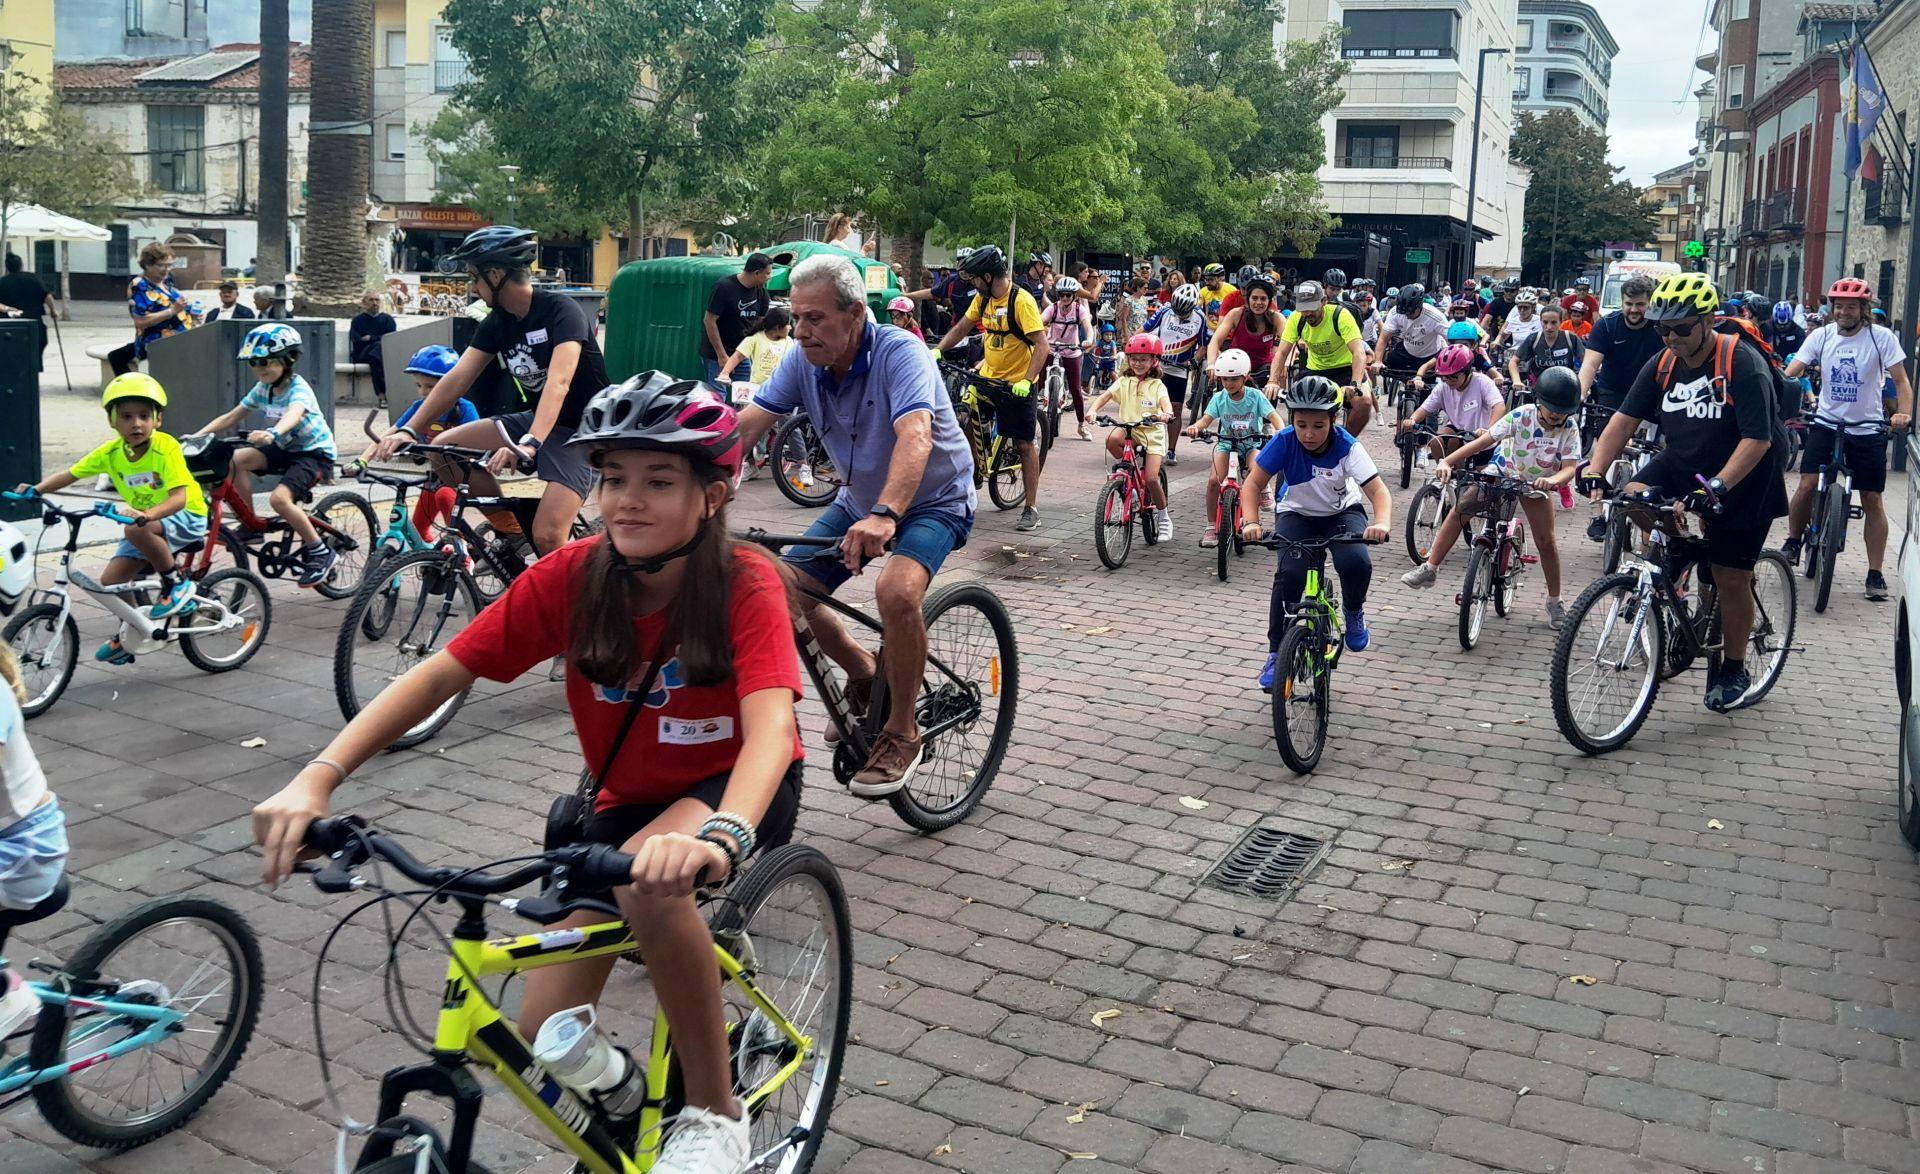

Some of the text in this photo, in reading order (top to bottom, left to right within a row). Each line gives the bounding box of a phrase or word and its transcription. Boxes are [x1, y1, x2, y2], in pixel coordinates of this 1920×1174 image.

[397, 210, 422, 220] BAZAR
[423, 210, 456, 220] CELESTE
[1167, 322, 1193, 337] Banesto
[1831, 386, 1858, 394] XXVIII
[793, 614, 861, 735] TREK
[680, 725, 696, 735] 20
